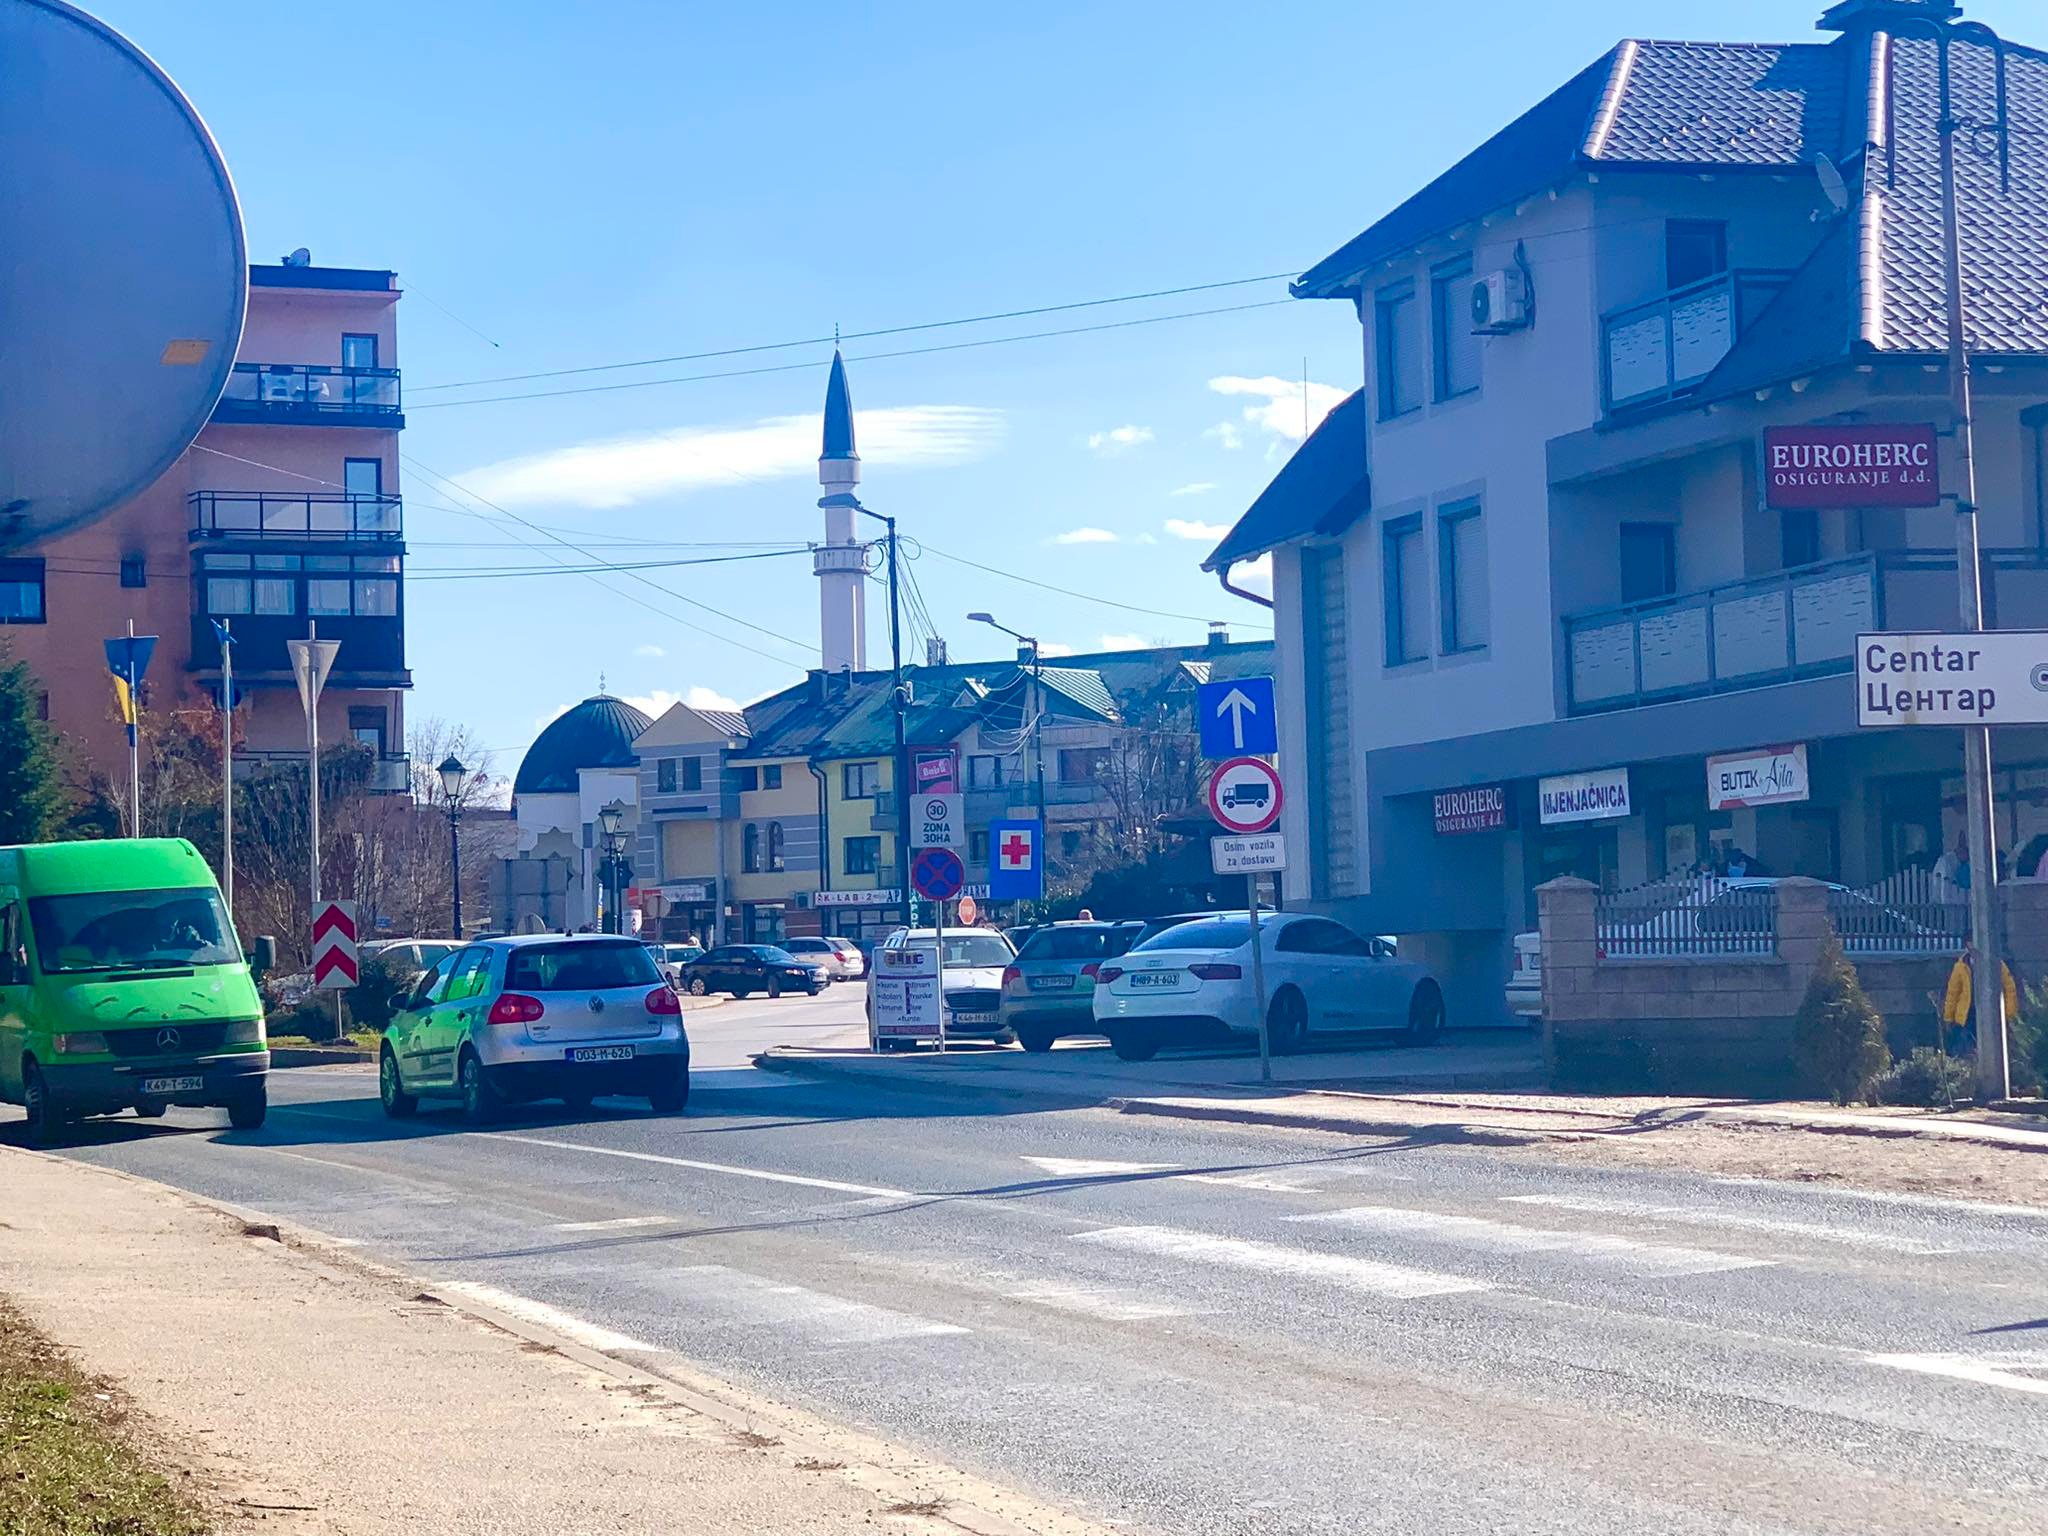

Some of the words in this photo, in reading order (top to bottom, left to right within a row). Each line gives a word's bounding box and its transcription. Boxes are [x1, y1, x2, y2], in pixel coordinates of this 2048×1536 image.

[1772, 443, 1929, 468] EUROHERC
[1775, 471, 1890, 487] OSIGURANJE
[1900, 470, 1932, 483] d.d.
[1866, 644, 1981, 673] Centar
[1867, 682, 1996, 717] Центар
[1721, 769, 1759, 791] BUTIK
[1434, 788, 1502, 818] EUROHERC
[1543, 783, 1626, 814] MJENJAČNICA
[929, 805, 944, 815] 30
[923, 823, 951, 832] ZONA
[1435, 816, 1486, 833] OSIGURANJE
[1223, 841, 1246, 852] Osim
[1249, 839, 1275, 850] vozila
[1226, 857, 1237, 866] za
[1241, 855, 1275, 865] dostavu
[146, 1077, 201, 1090] K49-T-594
